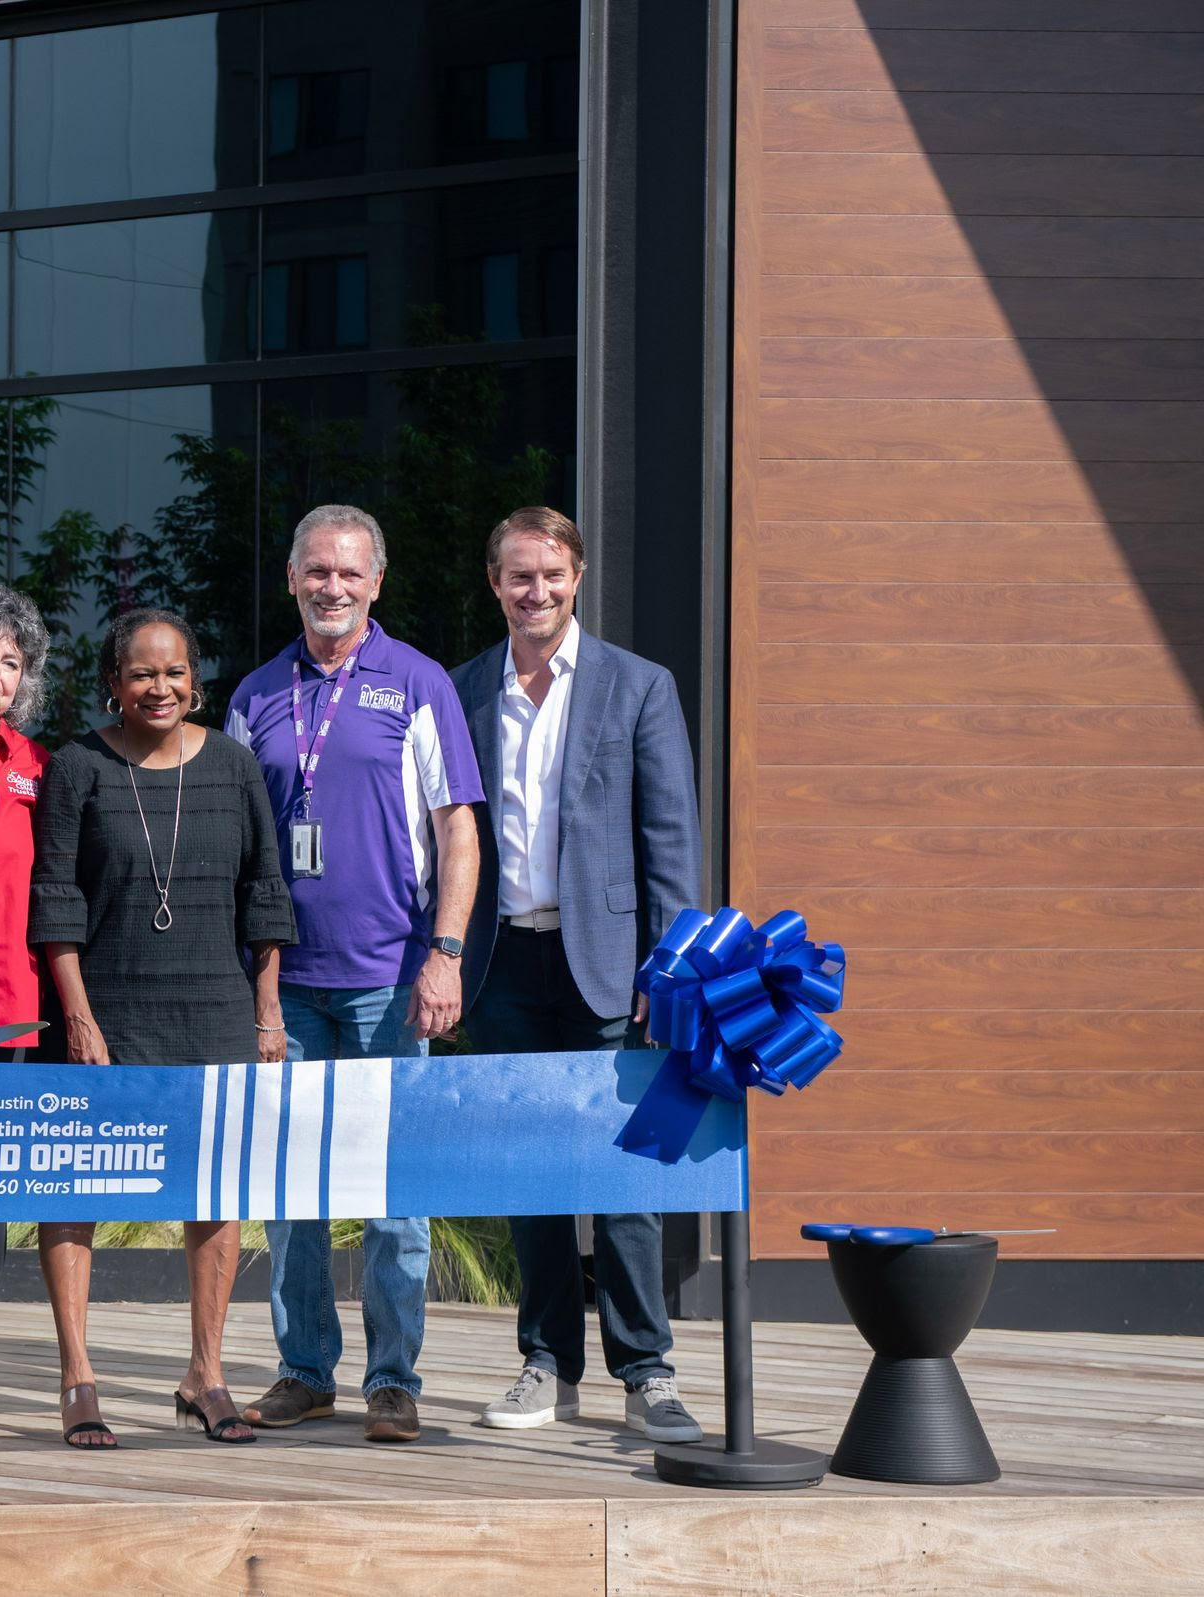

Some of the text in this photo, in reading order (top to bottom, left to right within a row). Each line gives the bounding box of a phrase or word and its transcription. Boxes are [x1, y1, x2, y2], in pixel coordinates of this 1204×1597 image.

[359, 691, 405, 708] RIVERBATS
[61, 1097, 89, 1110] PBS
[30, 1120, 93, 1137] Media
[99, 1121, 168, 1137] Center
[30, 1143, 166, 1171] OPENING
[24, 1178, 71, 1194] Years
